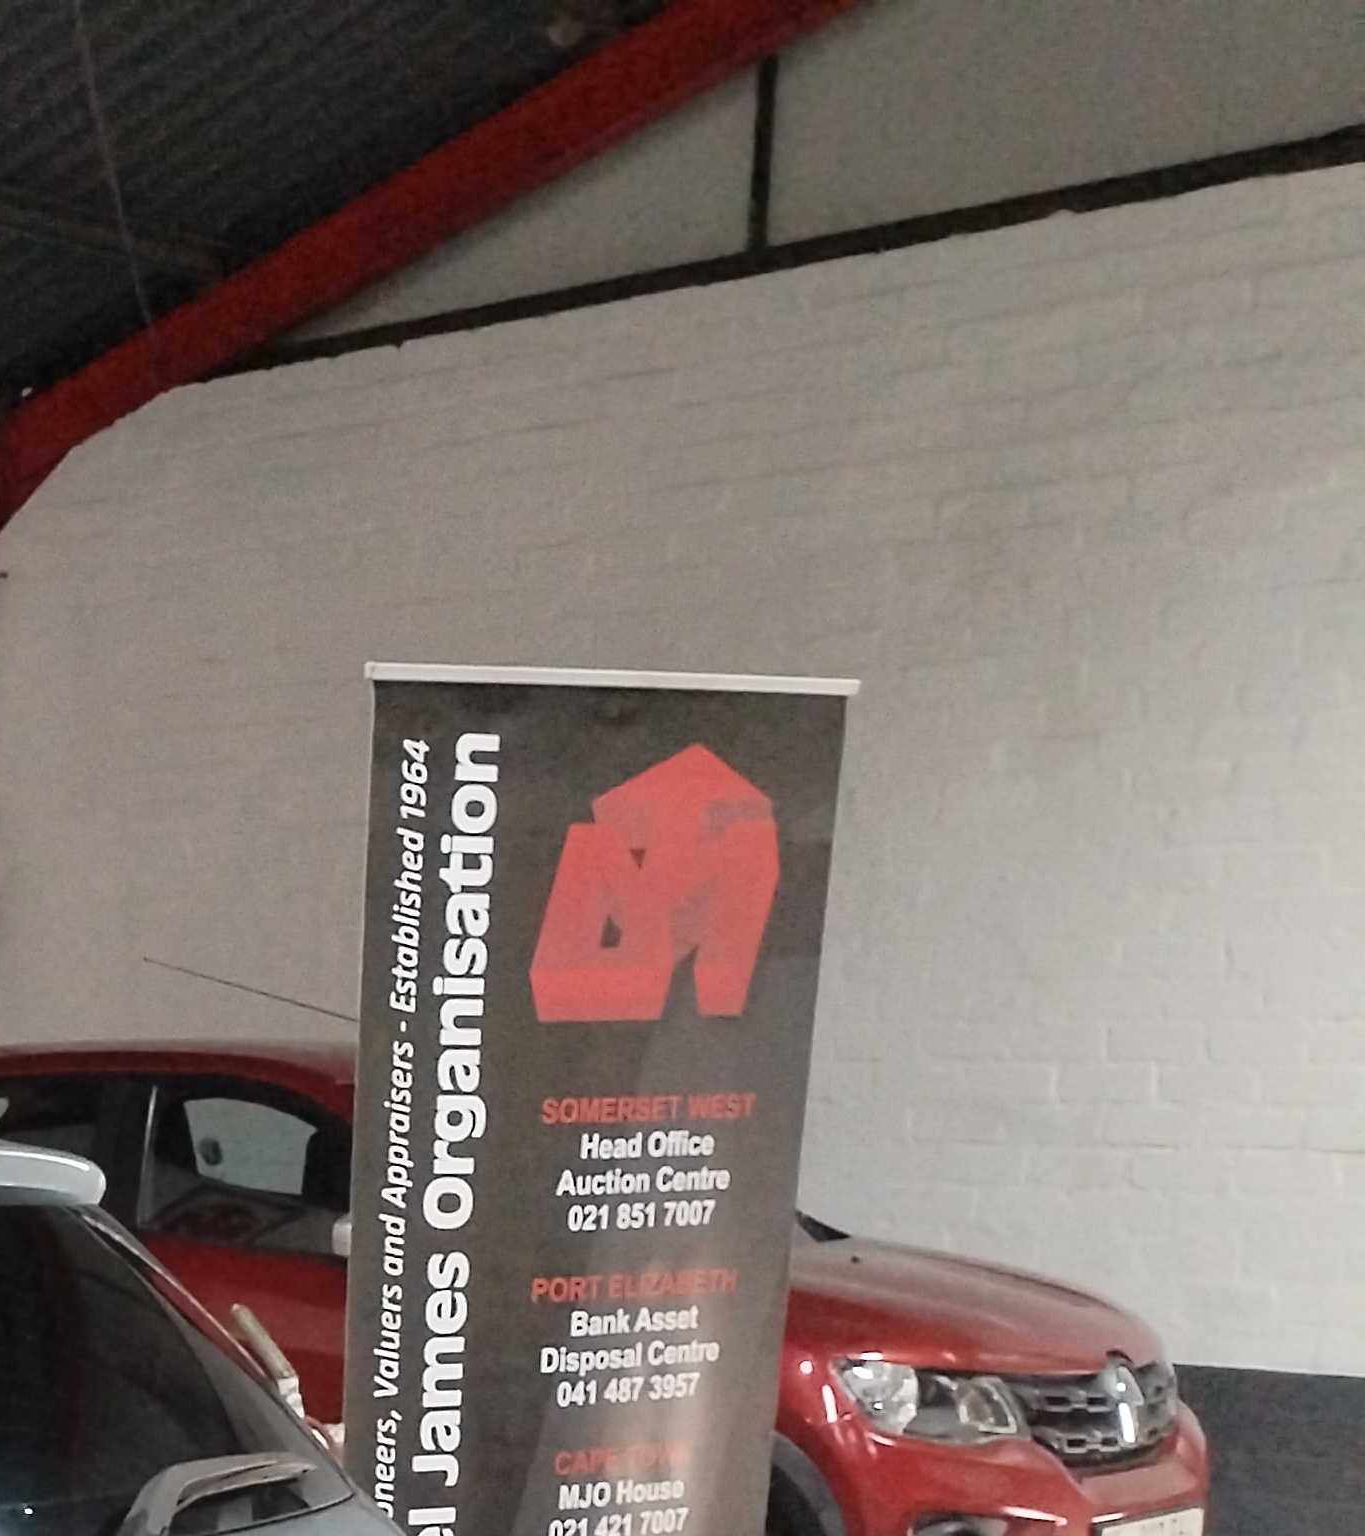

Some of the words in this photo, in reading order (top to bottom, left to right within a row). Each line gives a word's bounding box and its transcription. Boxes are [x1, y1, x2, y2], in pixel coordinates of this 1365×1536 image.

[399, 738, 431, 820] 1964
[388, 826, 425, 1013] Established
[422, 732, 501, 1230] Organisation
[381, 1040, 415, 1209] Appraisers
[541, 1095, 683, 1124] SOMERSET
[688, 1093, 757, 1120] WEST
[580, 1132, 643, 1160] Head
[647, 1129, 716, 1158] Office
[555, 1168, 651, 1196] Auction
[655, 1165, 731, 1193] Centre
[567, 1204, 610, 1232] 021
[615, 1202, 656, 1230] 851
[663, 1199, 716, 1227] 7007
[378, 1213, 406, 1277] and
[530, 1275, 602, 1304] PORT
[608, 1267, 739, 1299] ELIZABETH
[570, 1308, 630, 1337] Bank
[633, 1304, 700, 1333] Asset
[373, 1283, 403, 1398] Valuers
[539, 1341, 643, 1377] Disposal
[647, 1338, 720, 1367] Centre
[411, 1250, 471, 1487] James
[556, 1379, 597, 1408] 041
[604, 1376, 645, 1404] 487
[649, 1371, 701, 1401] 3957
[557, 1480, 612, 1511] MJO
[615, 1478, 686, 1505] House
[640, 1506, 690, 1536] 7007
